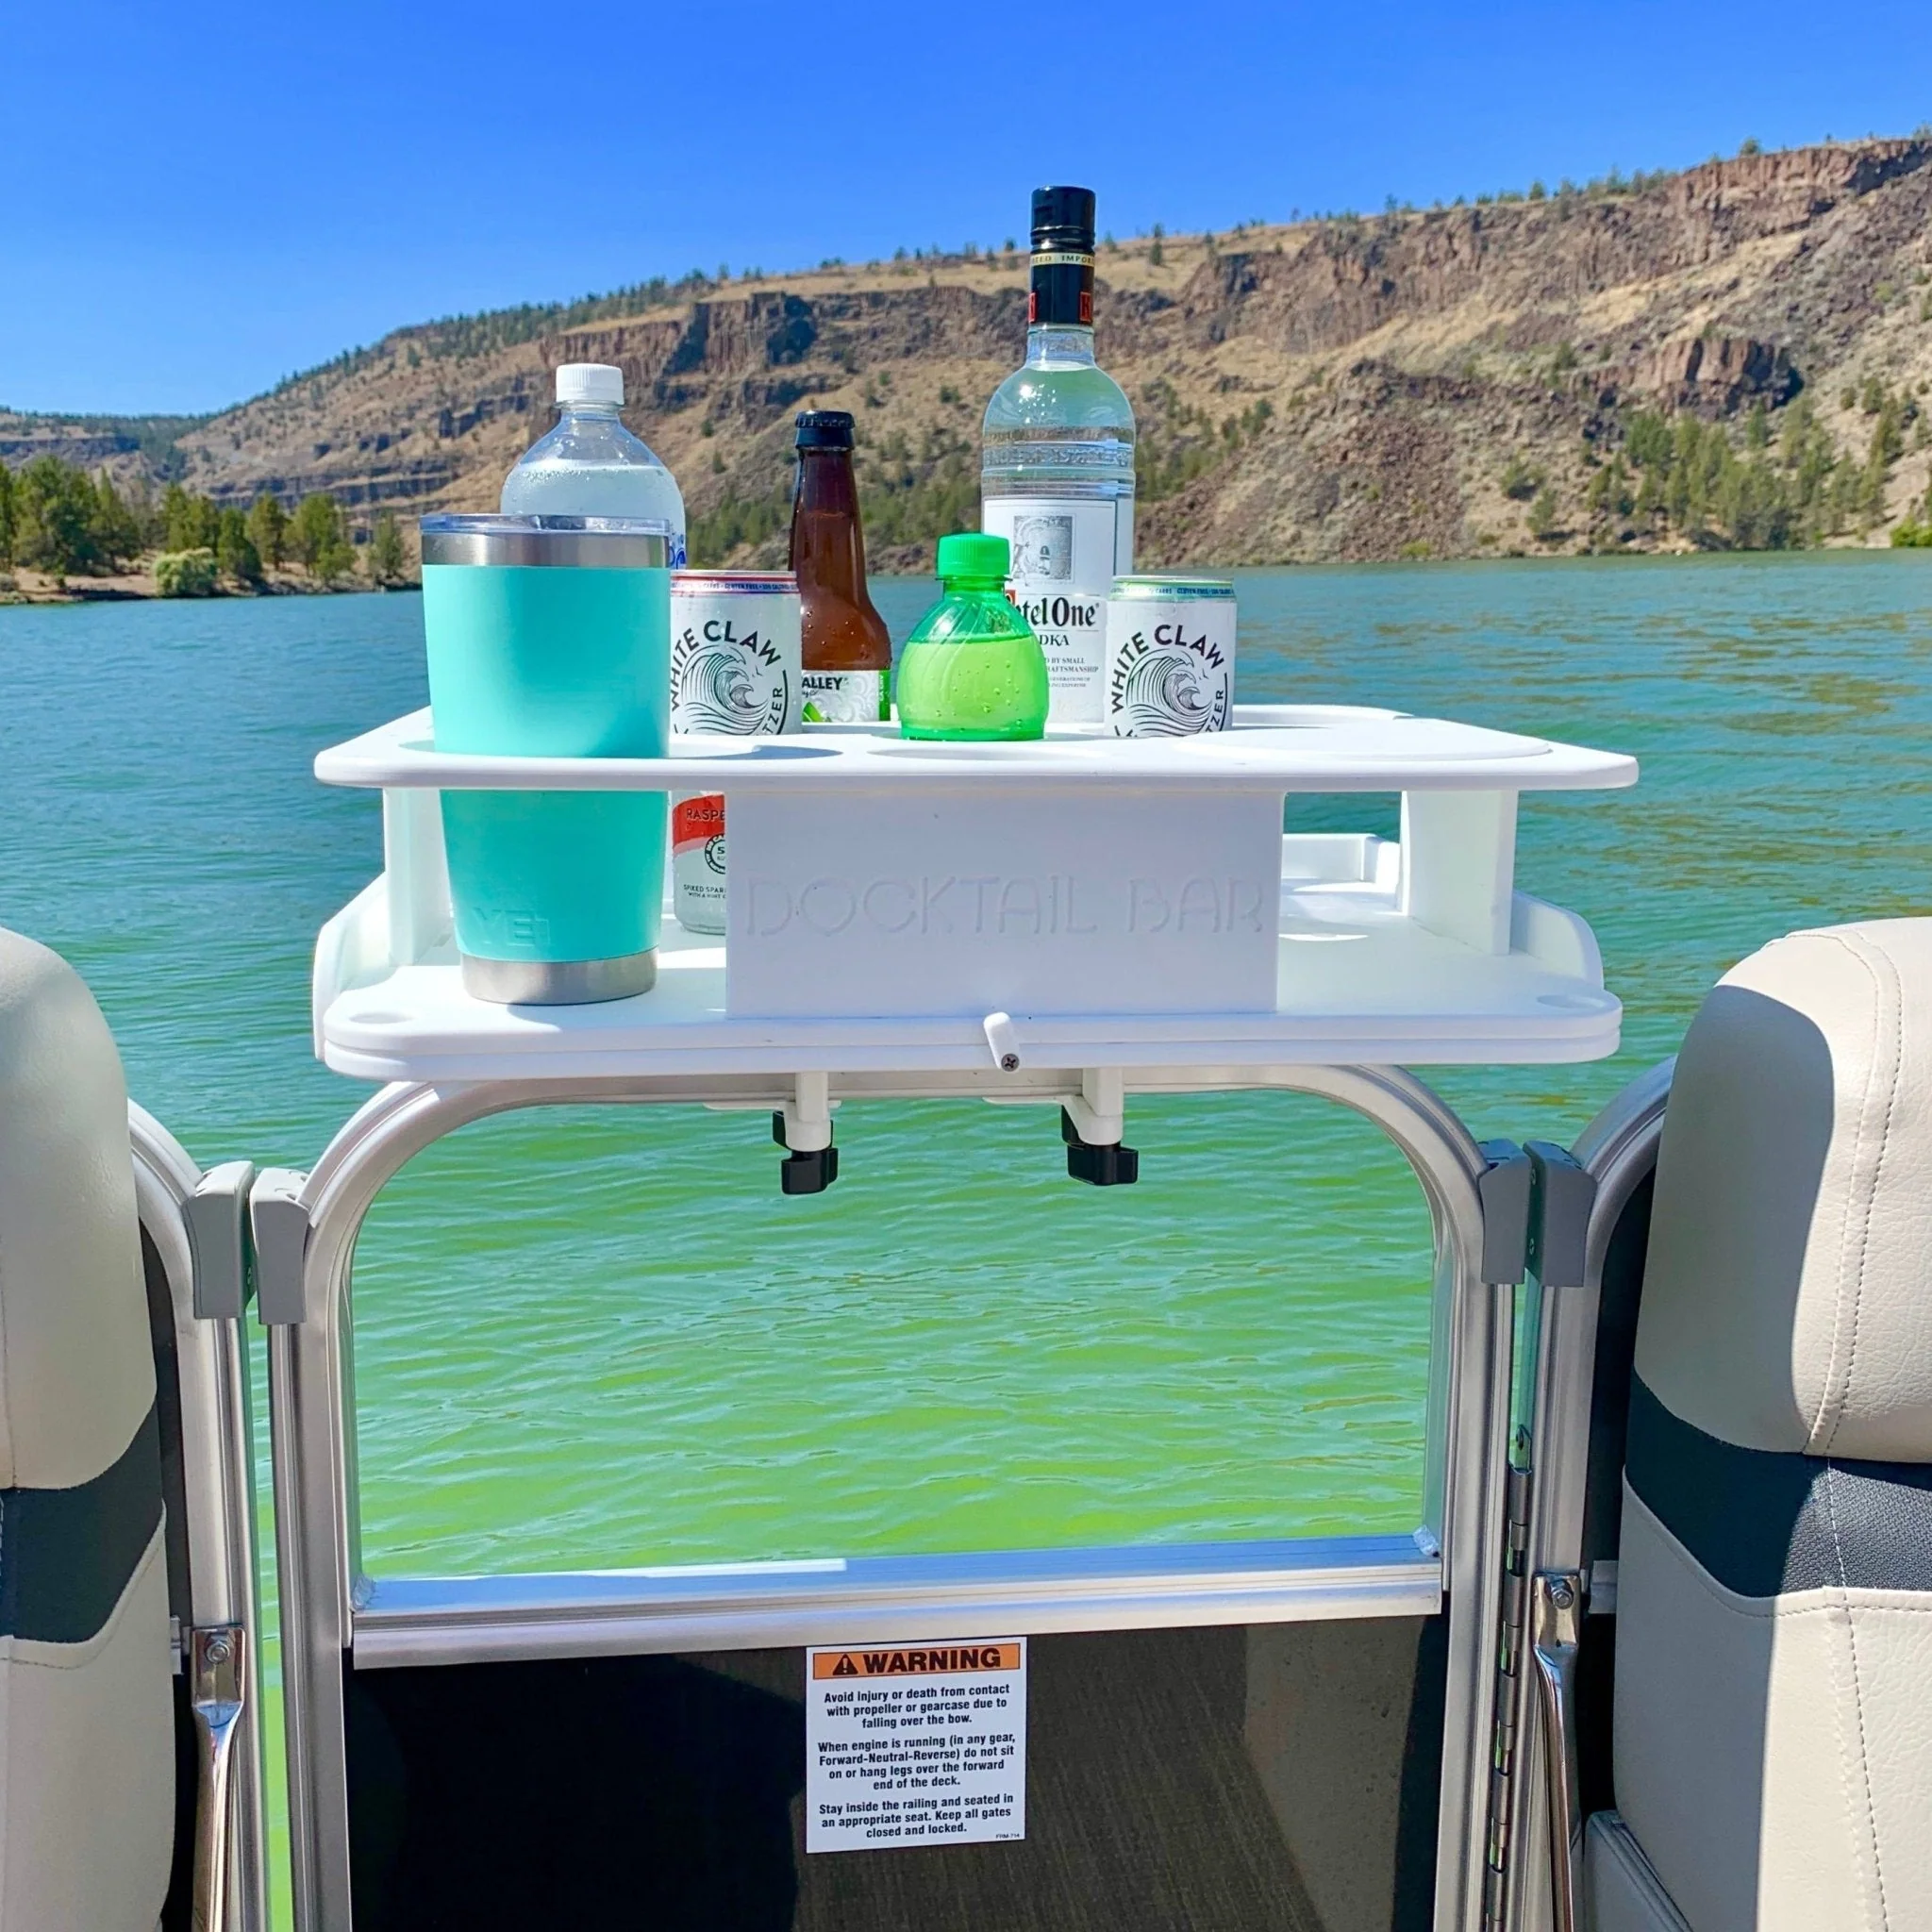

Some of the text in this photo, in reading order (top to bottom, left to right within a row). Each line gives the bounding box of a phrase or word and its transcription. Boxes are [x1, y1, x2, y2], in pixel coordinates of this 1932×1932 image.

[1007, 595, 1096, 626] tel One
[1039, 634, 1070, 646] DKA
[671, 620, 781, 712] WHITE CLAW
[1111, 624, 1224, 714] WHITE CLAW
[801, 676, 842, 691] ALLEY
[762, 687, 783, 735] TZER
[1205, 690, 1224, 733] TZER
[683, 884, 726, 893] SPIKED SPAR
[746, 876, 1264, 937] DOCKTAIL BAR
[863, 1647, 1001, 1674] WARNING
[824, 1684, 1009, 1704] Avoid injury or death from contact
[826, 1698, 1007, 1718] with propeller or gearcase due to
[862, 1713, 972, 1729] falling over the bow.
[818, 1734, 1015, 1753] When engine is running (in any gear,
[820, 1745, 1014, 1766] Forward-Neutral-Reverse) do not sit
[829, 1758, 1004, 1779] on or hang legs over the forward
[874, 1775, 960, 1790] end of the deck.
[819, 1793, 1013, 1816] Stay inside the railing and seated in
[822, 1807, 1011, 1828] an appropriate seat. Keep all gates
[866, 1822, 967, 1838] closed and locked.
